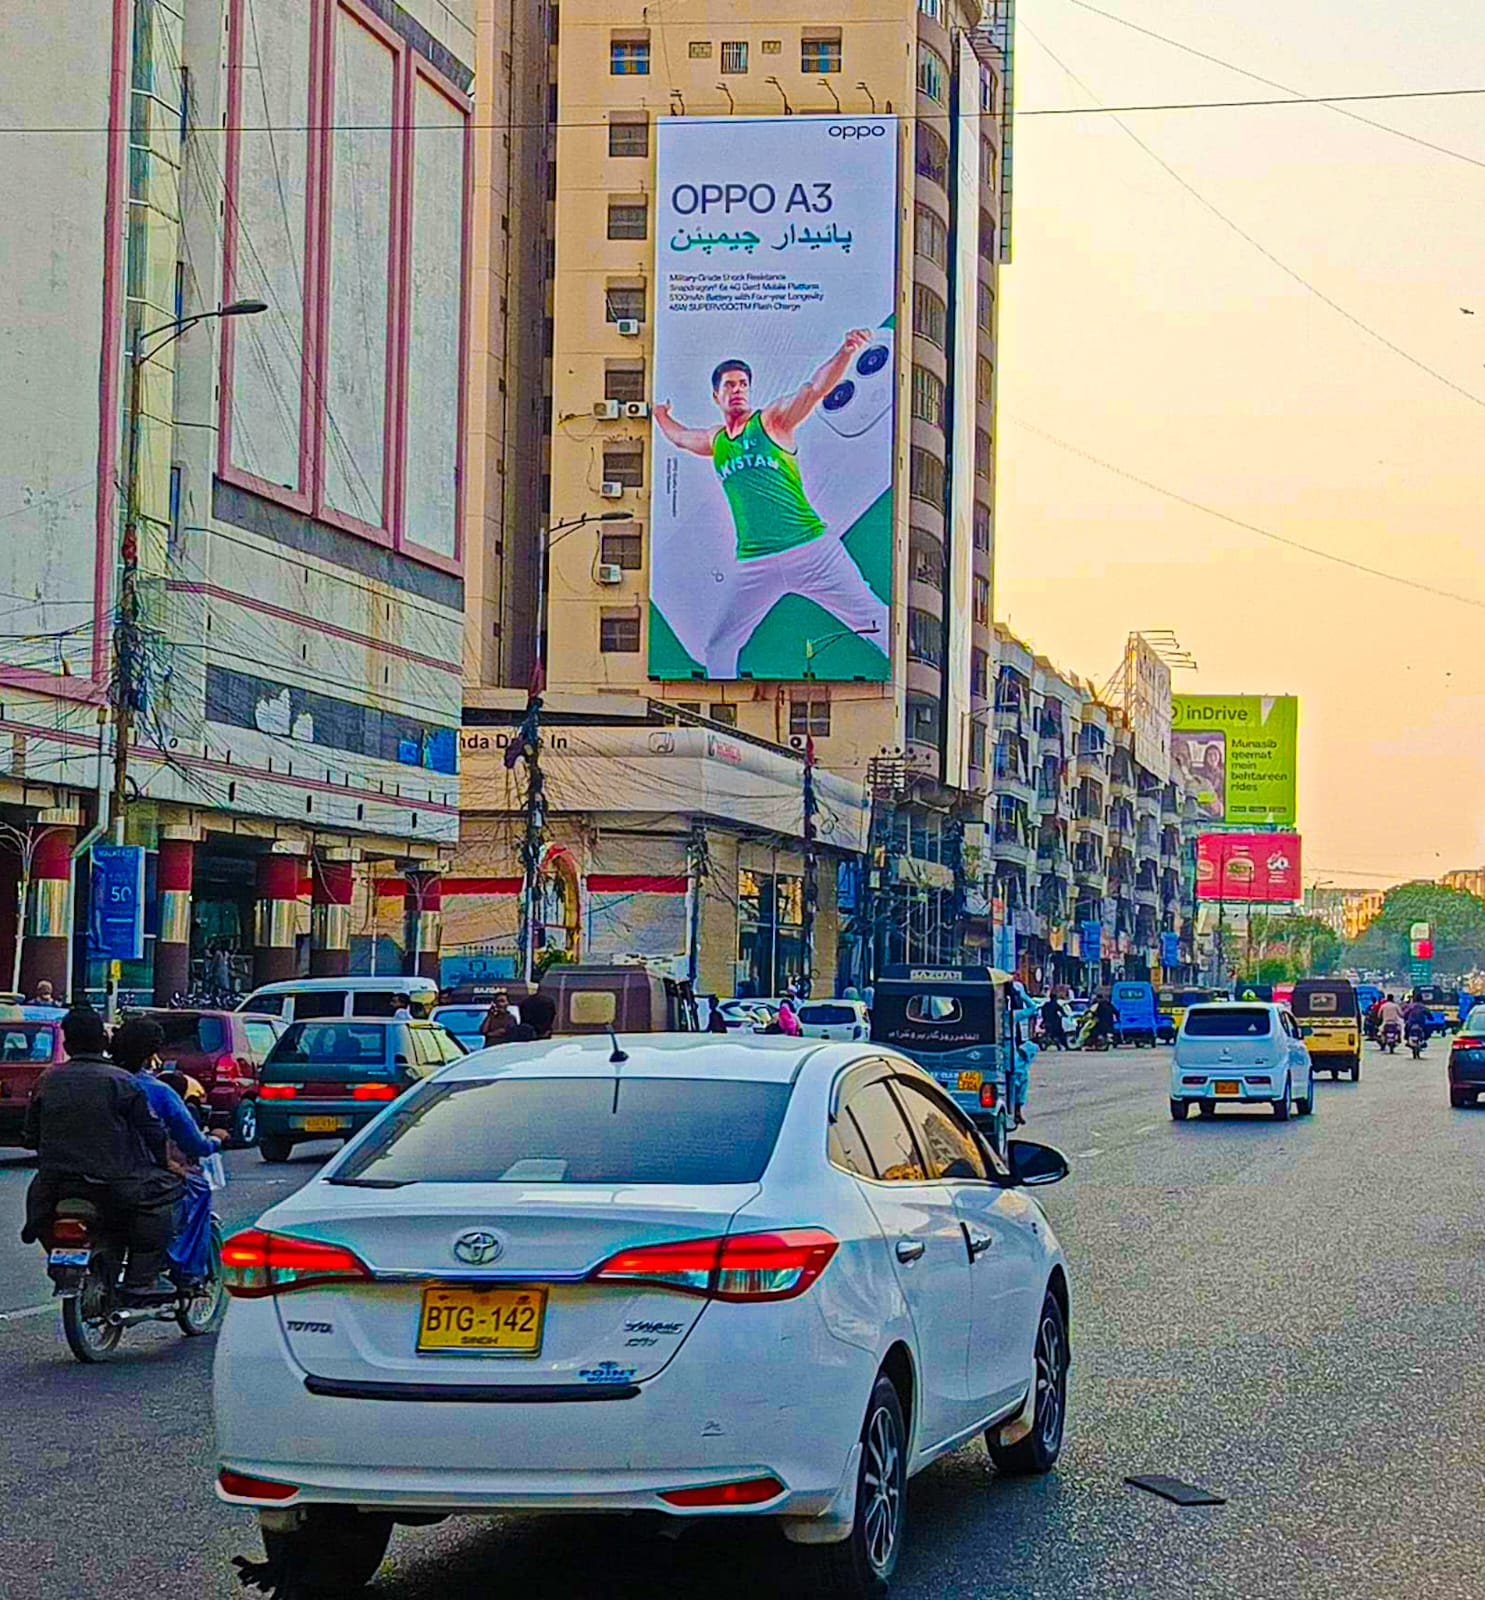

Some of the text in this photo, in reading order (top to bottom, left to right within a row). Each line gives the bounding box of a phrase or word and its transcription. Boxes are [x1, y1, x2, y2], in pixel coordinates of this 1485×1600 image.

[671, 183, 833, 215] OPPO A3
[1186, 704, 1248, 721] inDrive
[551, 734, 567, 749] In
[1230, 781, 1258, 791] rides
[426, 1305, 535, 1332] BTG-142
